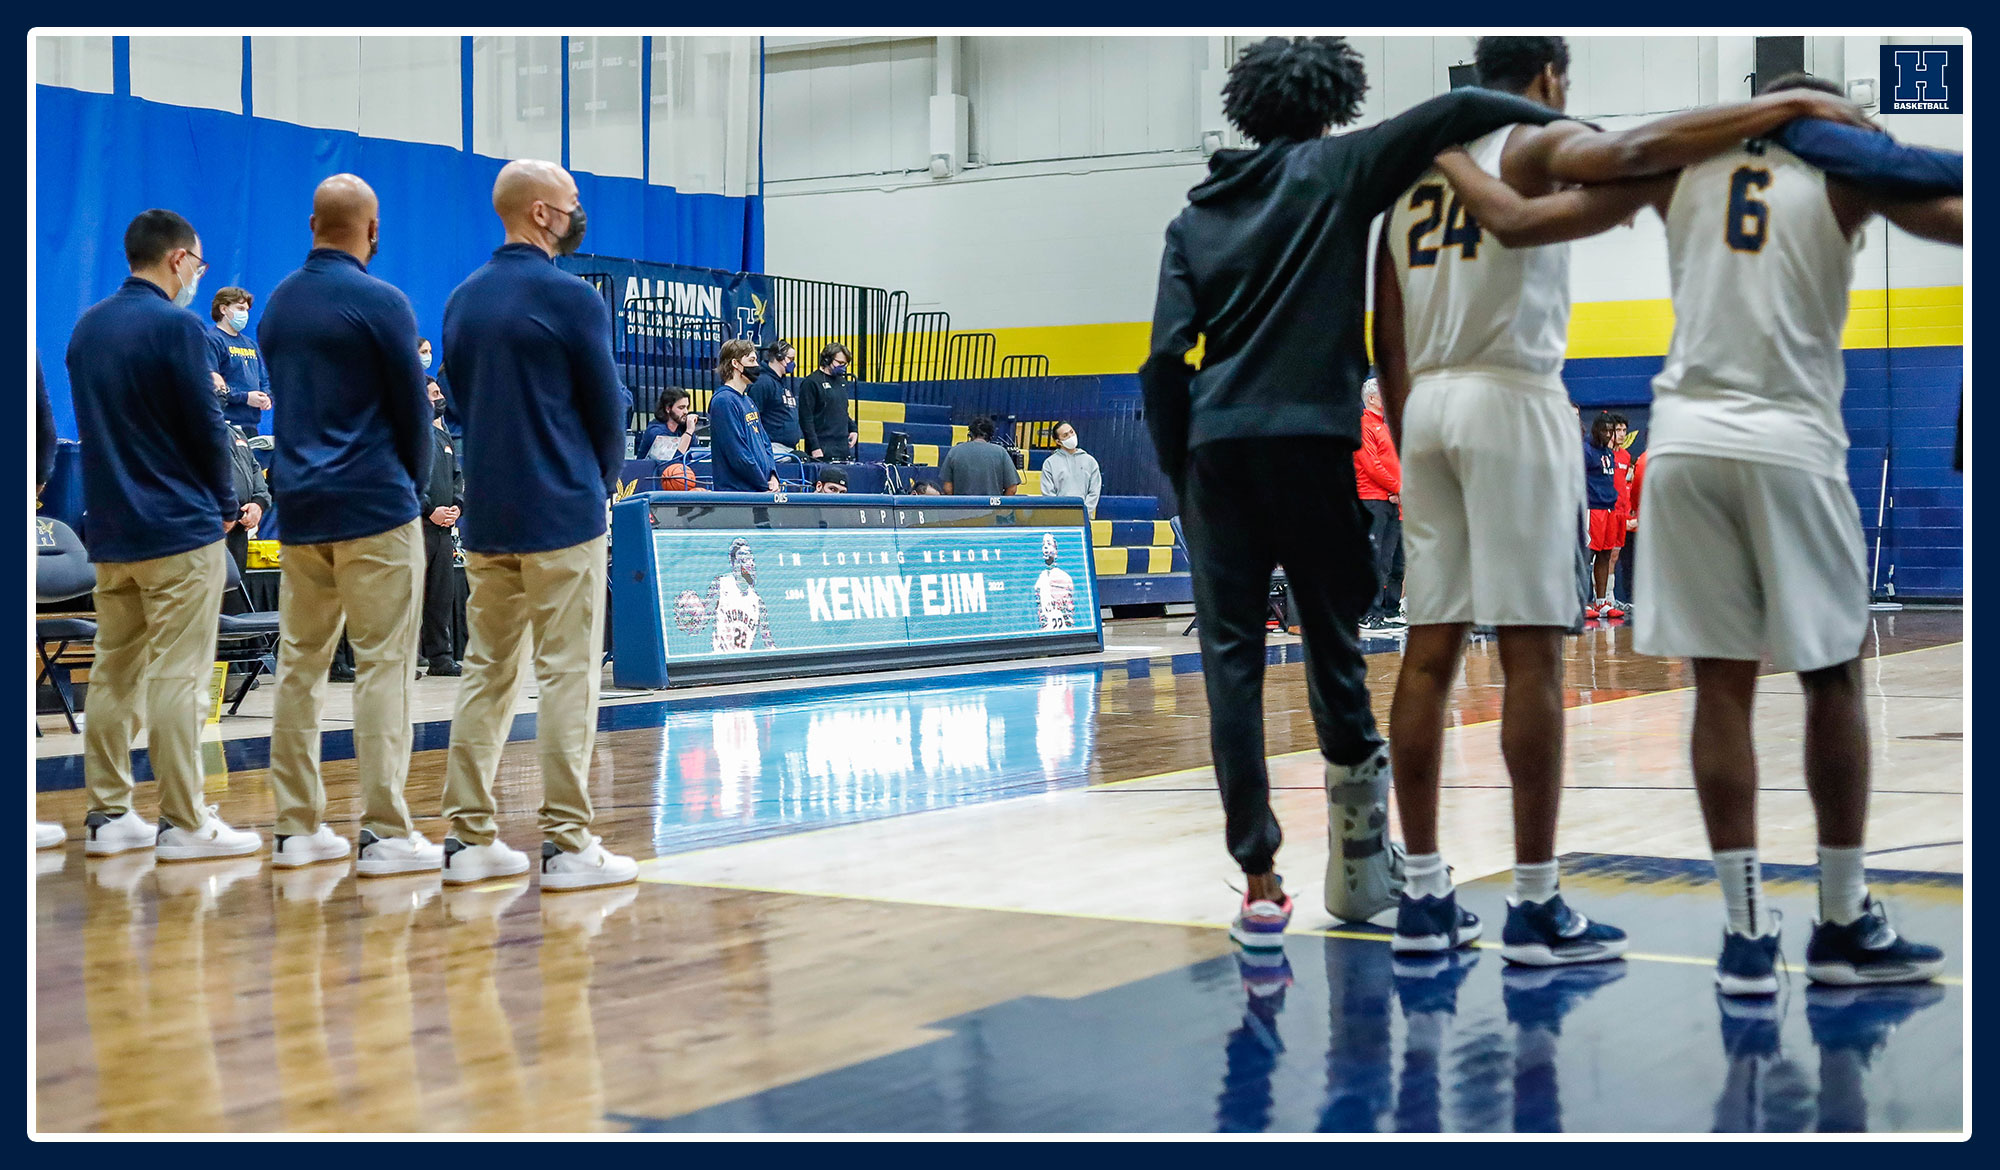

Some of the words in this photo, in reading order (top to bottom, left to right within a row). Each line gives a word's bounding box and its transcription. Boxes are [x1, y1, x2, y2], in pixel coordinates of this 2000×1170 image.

[1407, 183, 1483, 269] 24
[1724, 164, 1776, 254] 6
[624, 276, 723, 318] ALUMNI
[860, 510, 867, 524] B
[880, 510, 887, 524] P
[900, 511, 906, 525] P
[918, 511, 925, 525] B
[779, 553, 801, 567] IN
[822, 551, 905, 566] LOVING
[923, 549, 1001, 563] MEMORY
[806, 575, 913, 622] KENNY
[920, 573, 988, 616] EJIM
